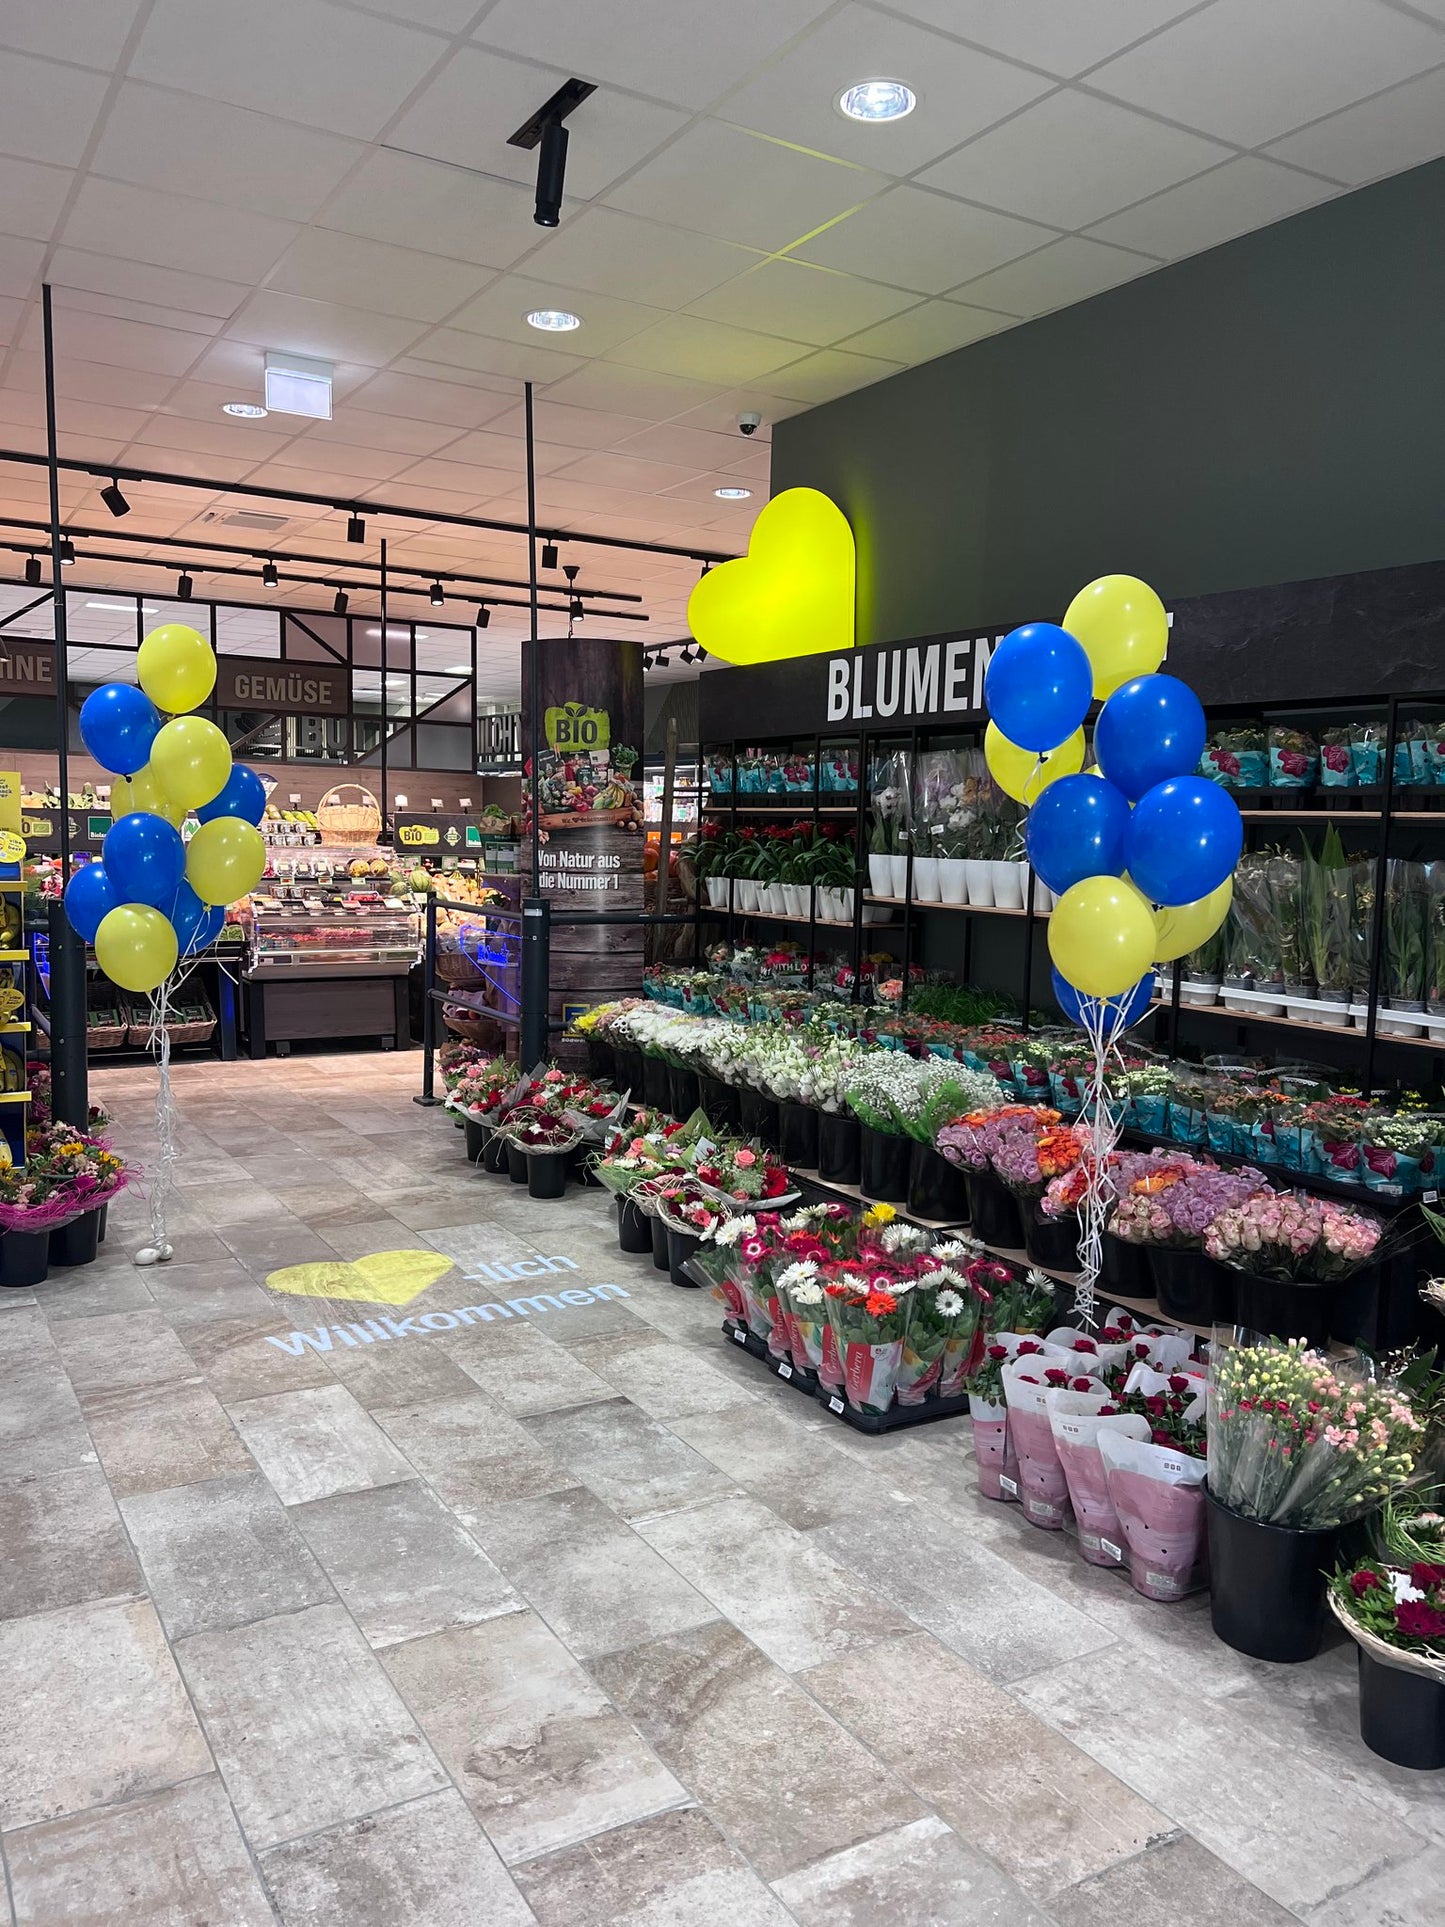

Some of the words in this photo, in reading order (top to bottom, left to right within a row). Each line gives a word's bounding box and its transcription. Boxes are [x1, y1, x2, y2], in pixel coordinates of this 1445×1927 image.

[0, 654, 52, 682] INE
[827, 635, 1005, 722] BLUMEN
[234, 672, 333, 705] GEMÜSE
[556, 719, 598, 744] BIO
[404, 830, 422, 842] BIO
[538, 850, 557, 868] Von
[560, 850, 595, 868] Natur
[598, 855, 621, 868] aus
[539, 873, 555, 888] die
[558, 873, 611, 890] Nummer
[613, 874, 619, 890] 1
[462, 1254, 580, 1282] -lich
[264, 1282, 631, 1357] Willkommen
